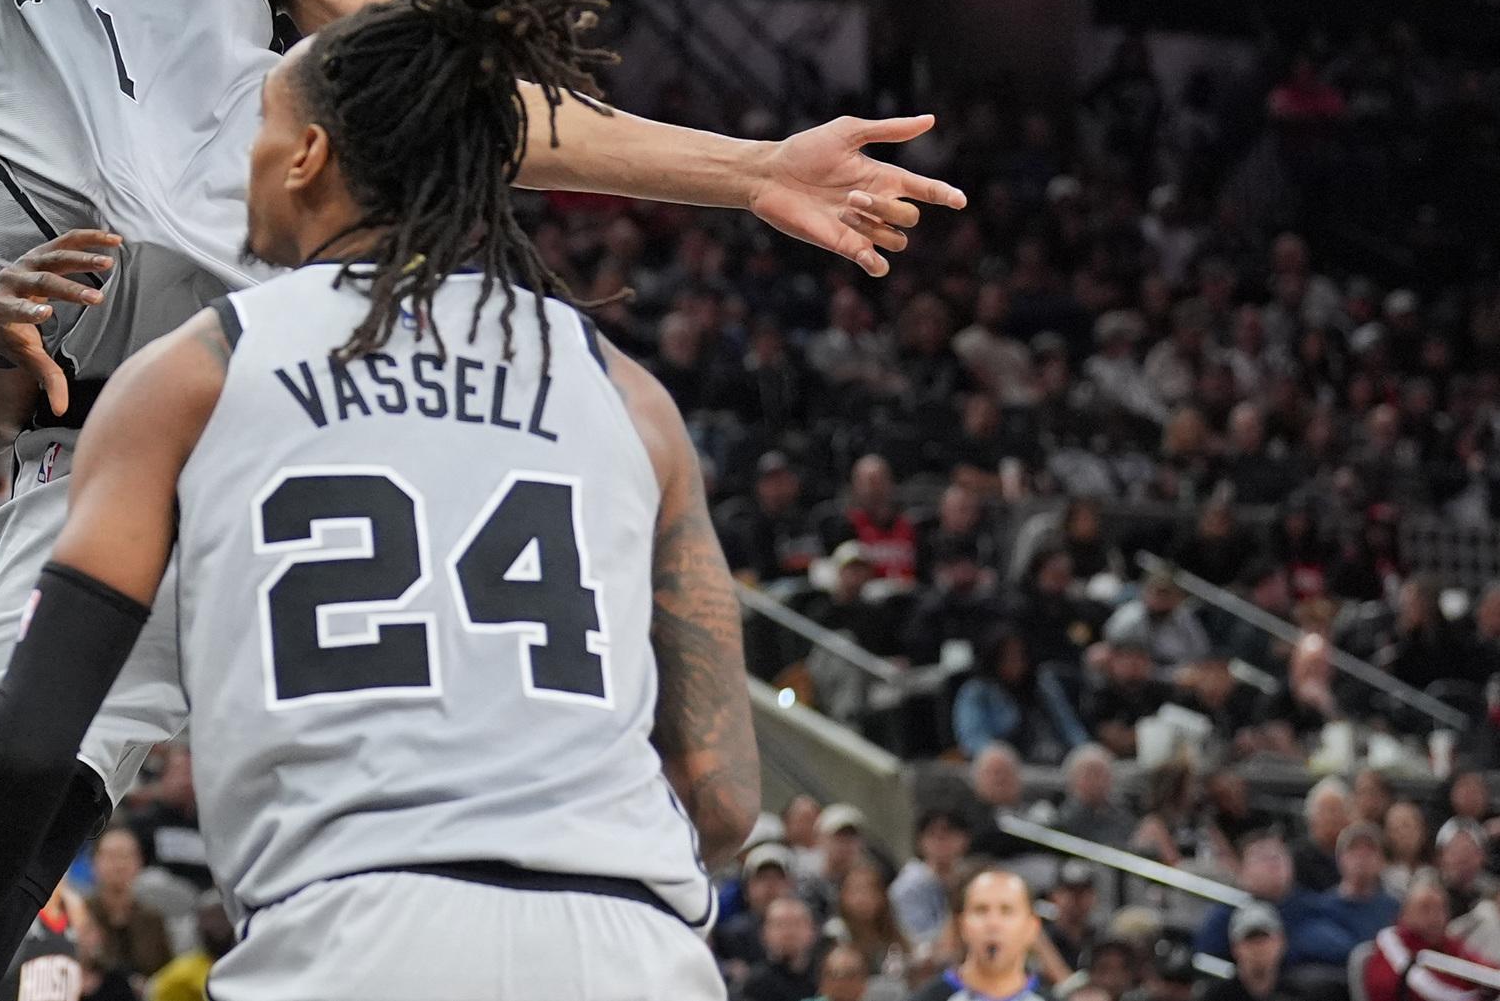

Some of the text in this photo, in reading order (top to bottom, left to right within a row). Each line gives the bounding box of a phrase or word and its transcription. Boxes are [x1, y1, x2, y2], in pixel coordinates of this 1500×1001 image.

[94, 6, 138, 104] 1
[273, 353, 559, 442] VASSELL
[250, 463, 616, 711] 24
